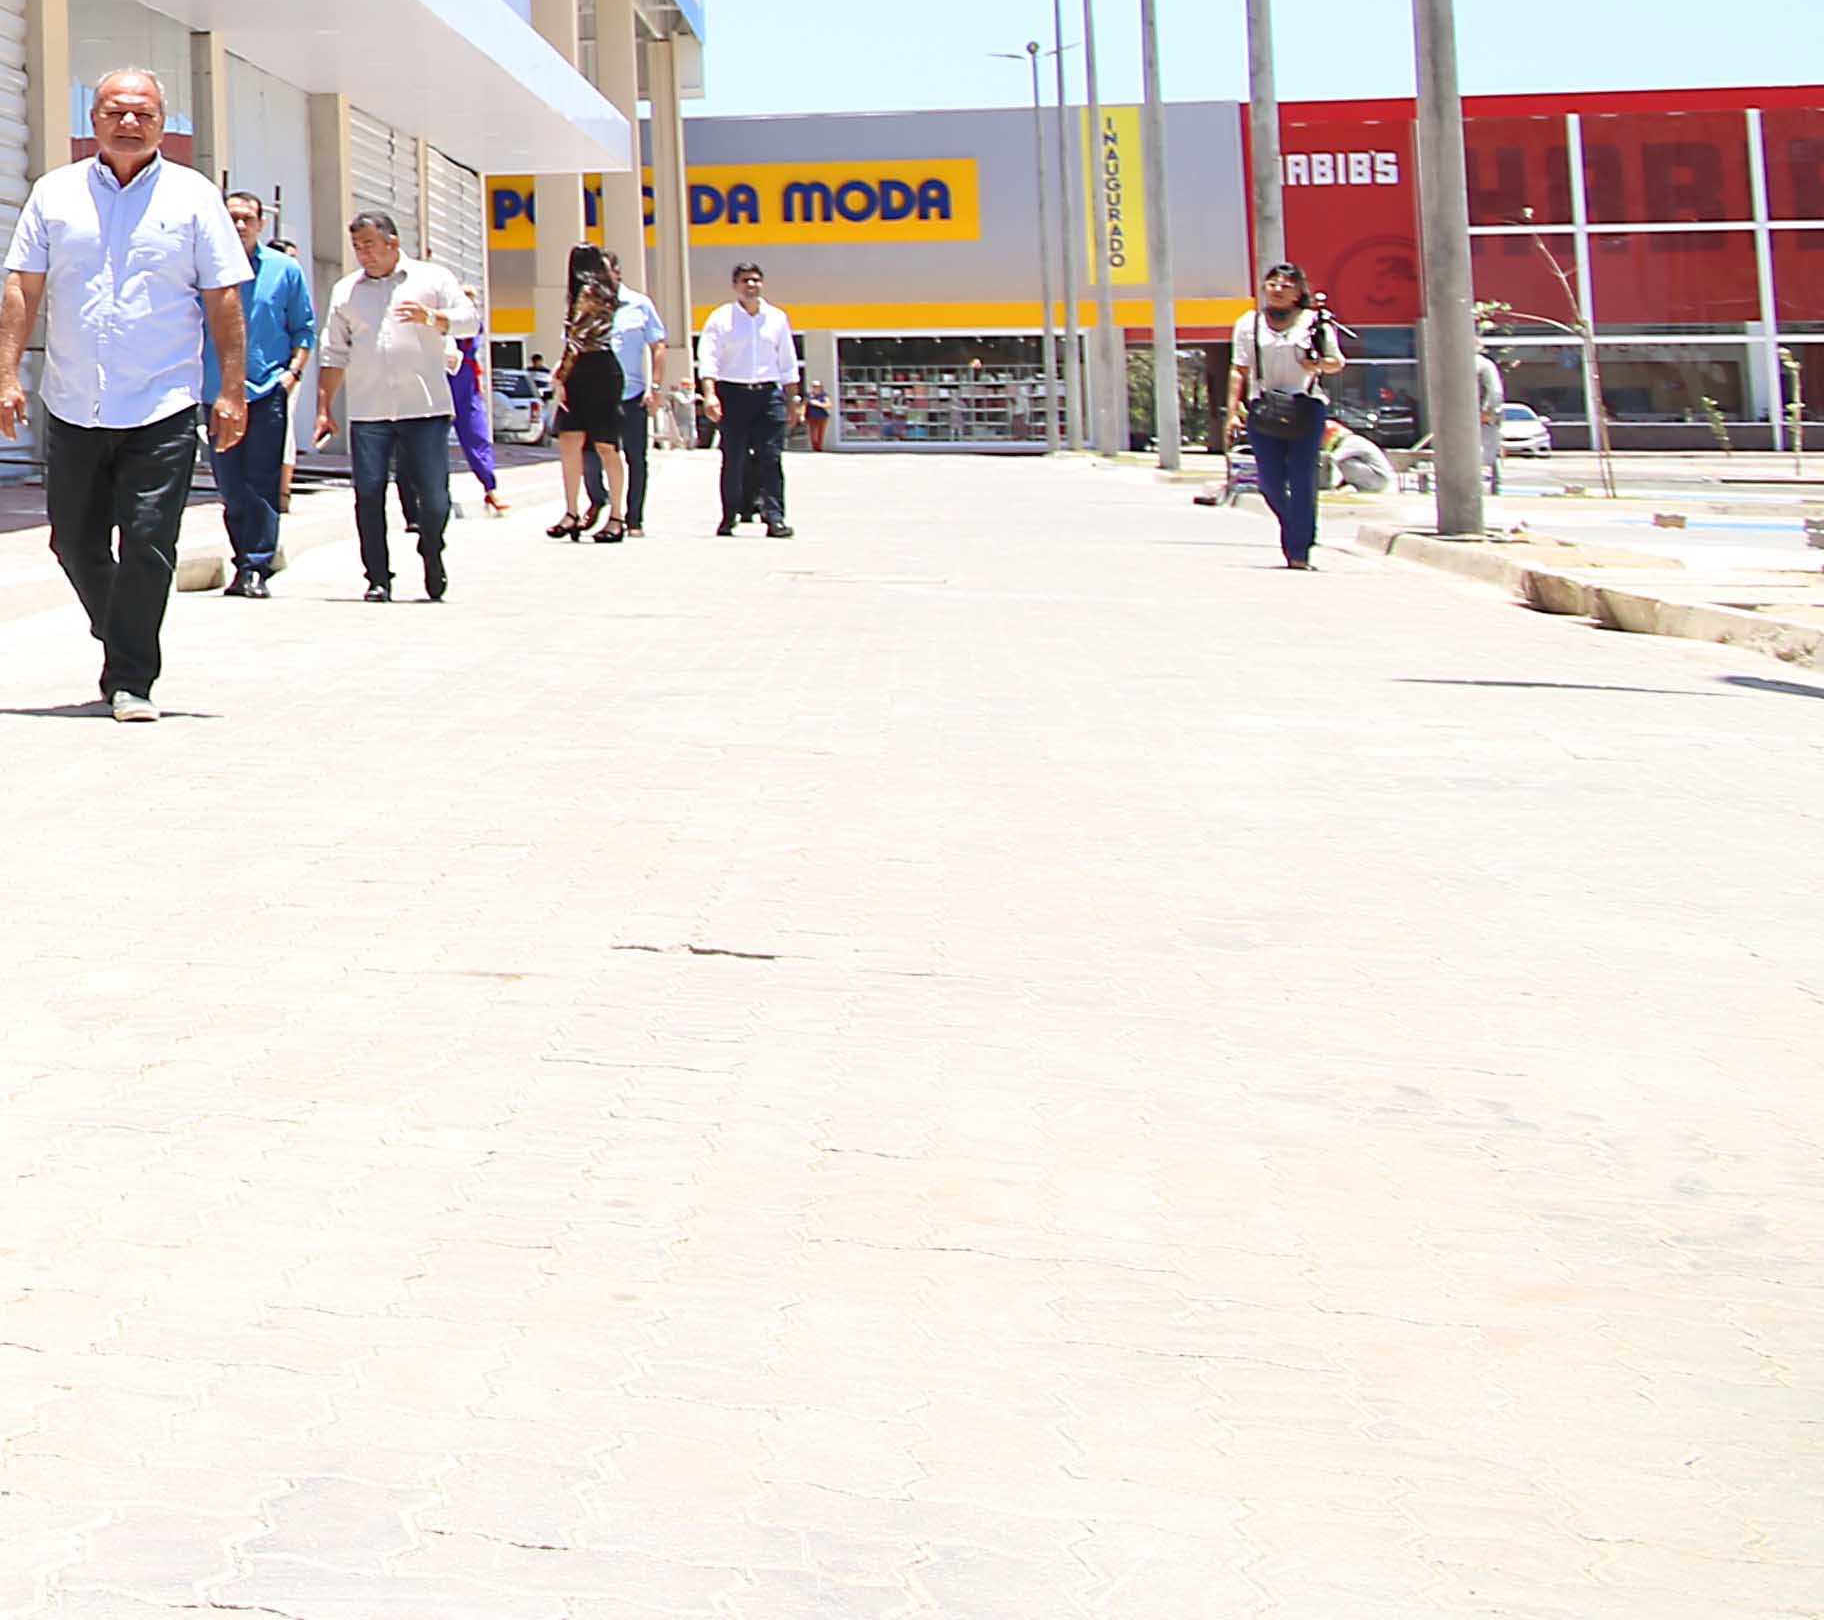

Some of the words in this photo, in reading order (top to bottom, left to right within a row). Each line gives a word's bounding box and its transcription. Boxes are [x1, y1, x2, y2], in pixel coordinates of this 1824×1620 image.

[1280, 150, 1399, 186] ABIB'S
[689, 183, 759, 224] DA
[782, 179, 951, 222] MODA
[1103, 116, 1126, 268] INAUGURADO
